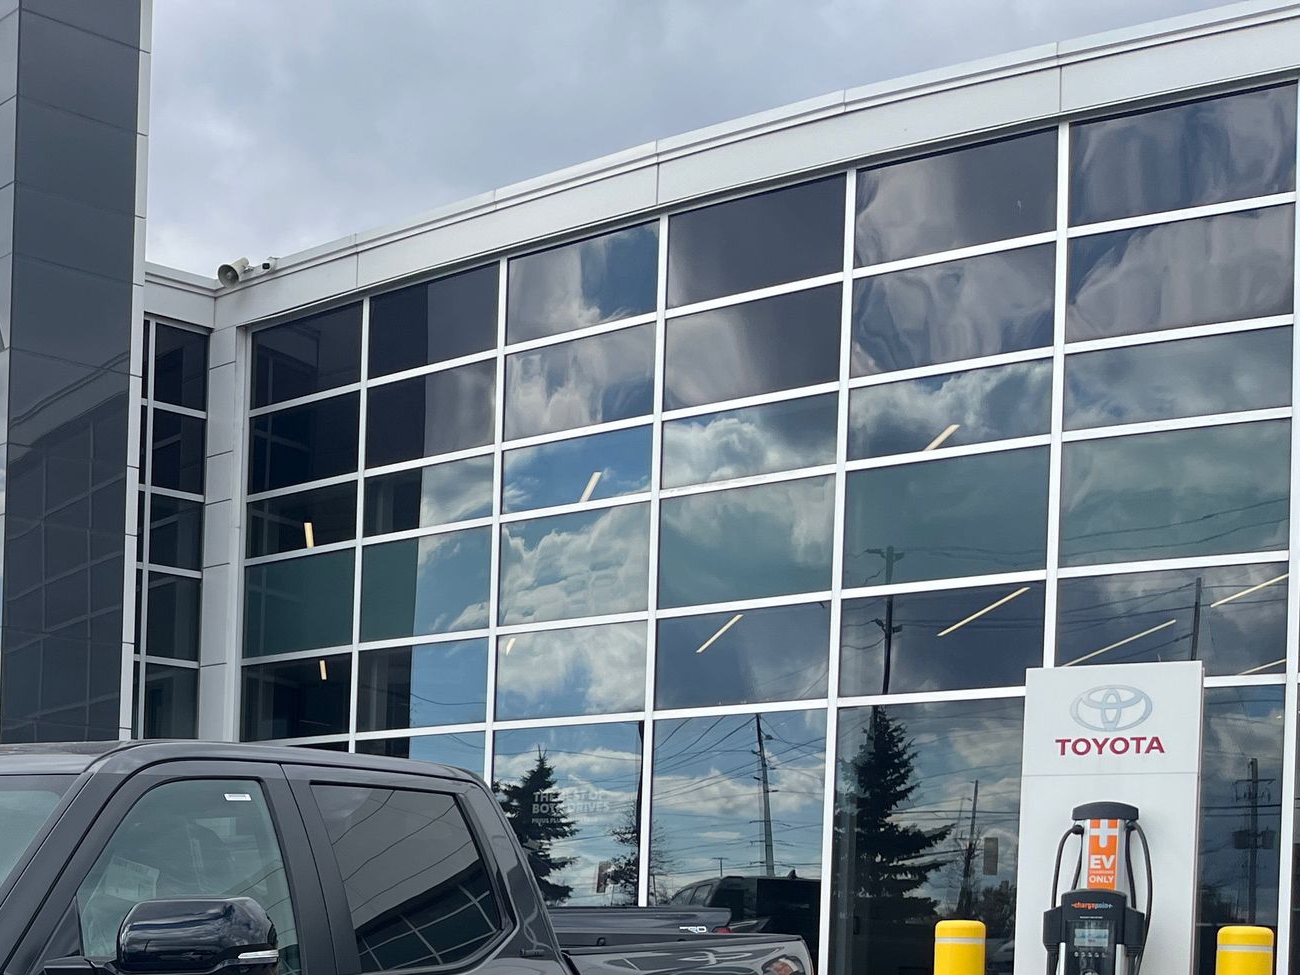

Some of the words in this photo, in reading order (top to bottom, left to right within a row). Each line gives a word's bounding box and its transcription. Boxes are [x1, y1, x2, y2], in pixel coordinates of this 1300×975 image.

[1055, 736, 1165, 756] TOYOTA
[1090, 854, 1115, 869] EV
[1088, 875, 1115, 884] ONLY
